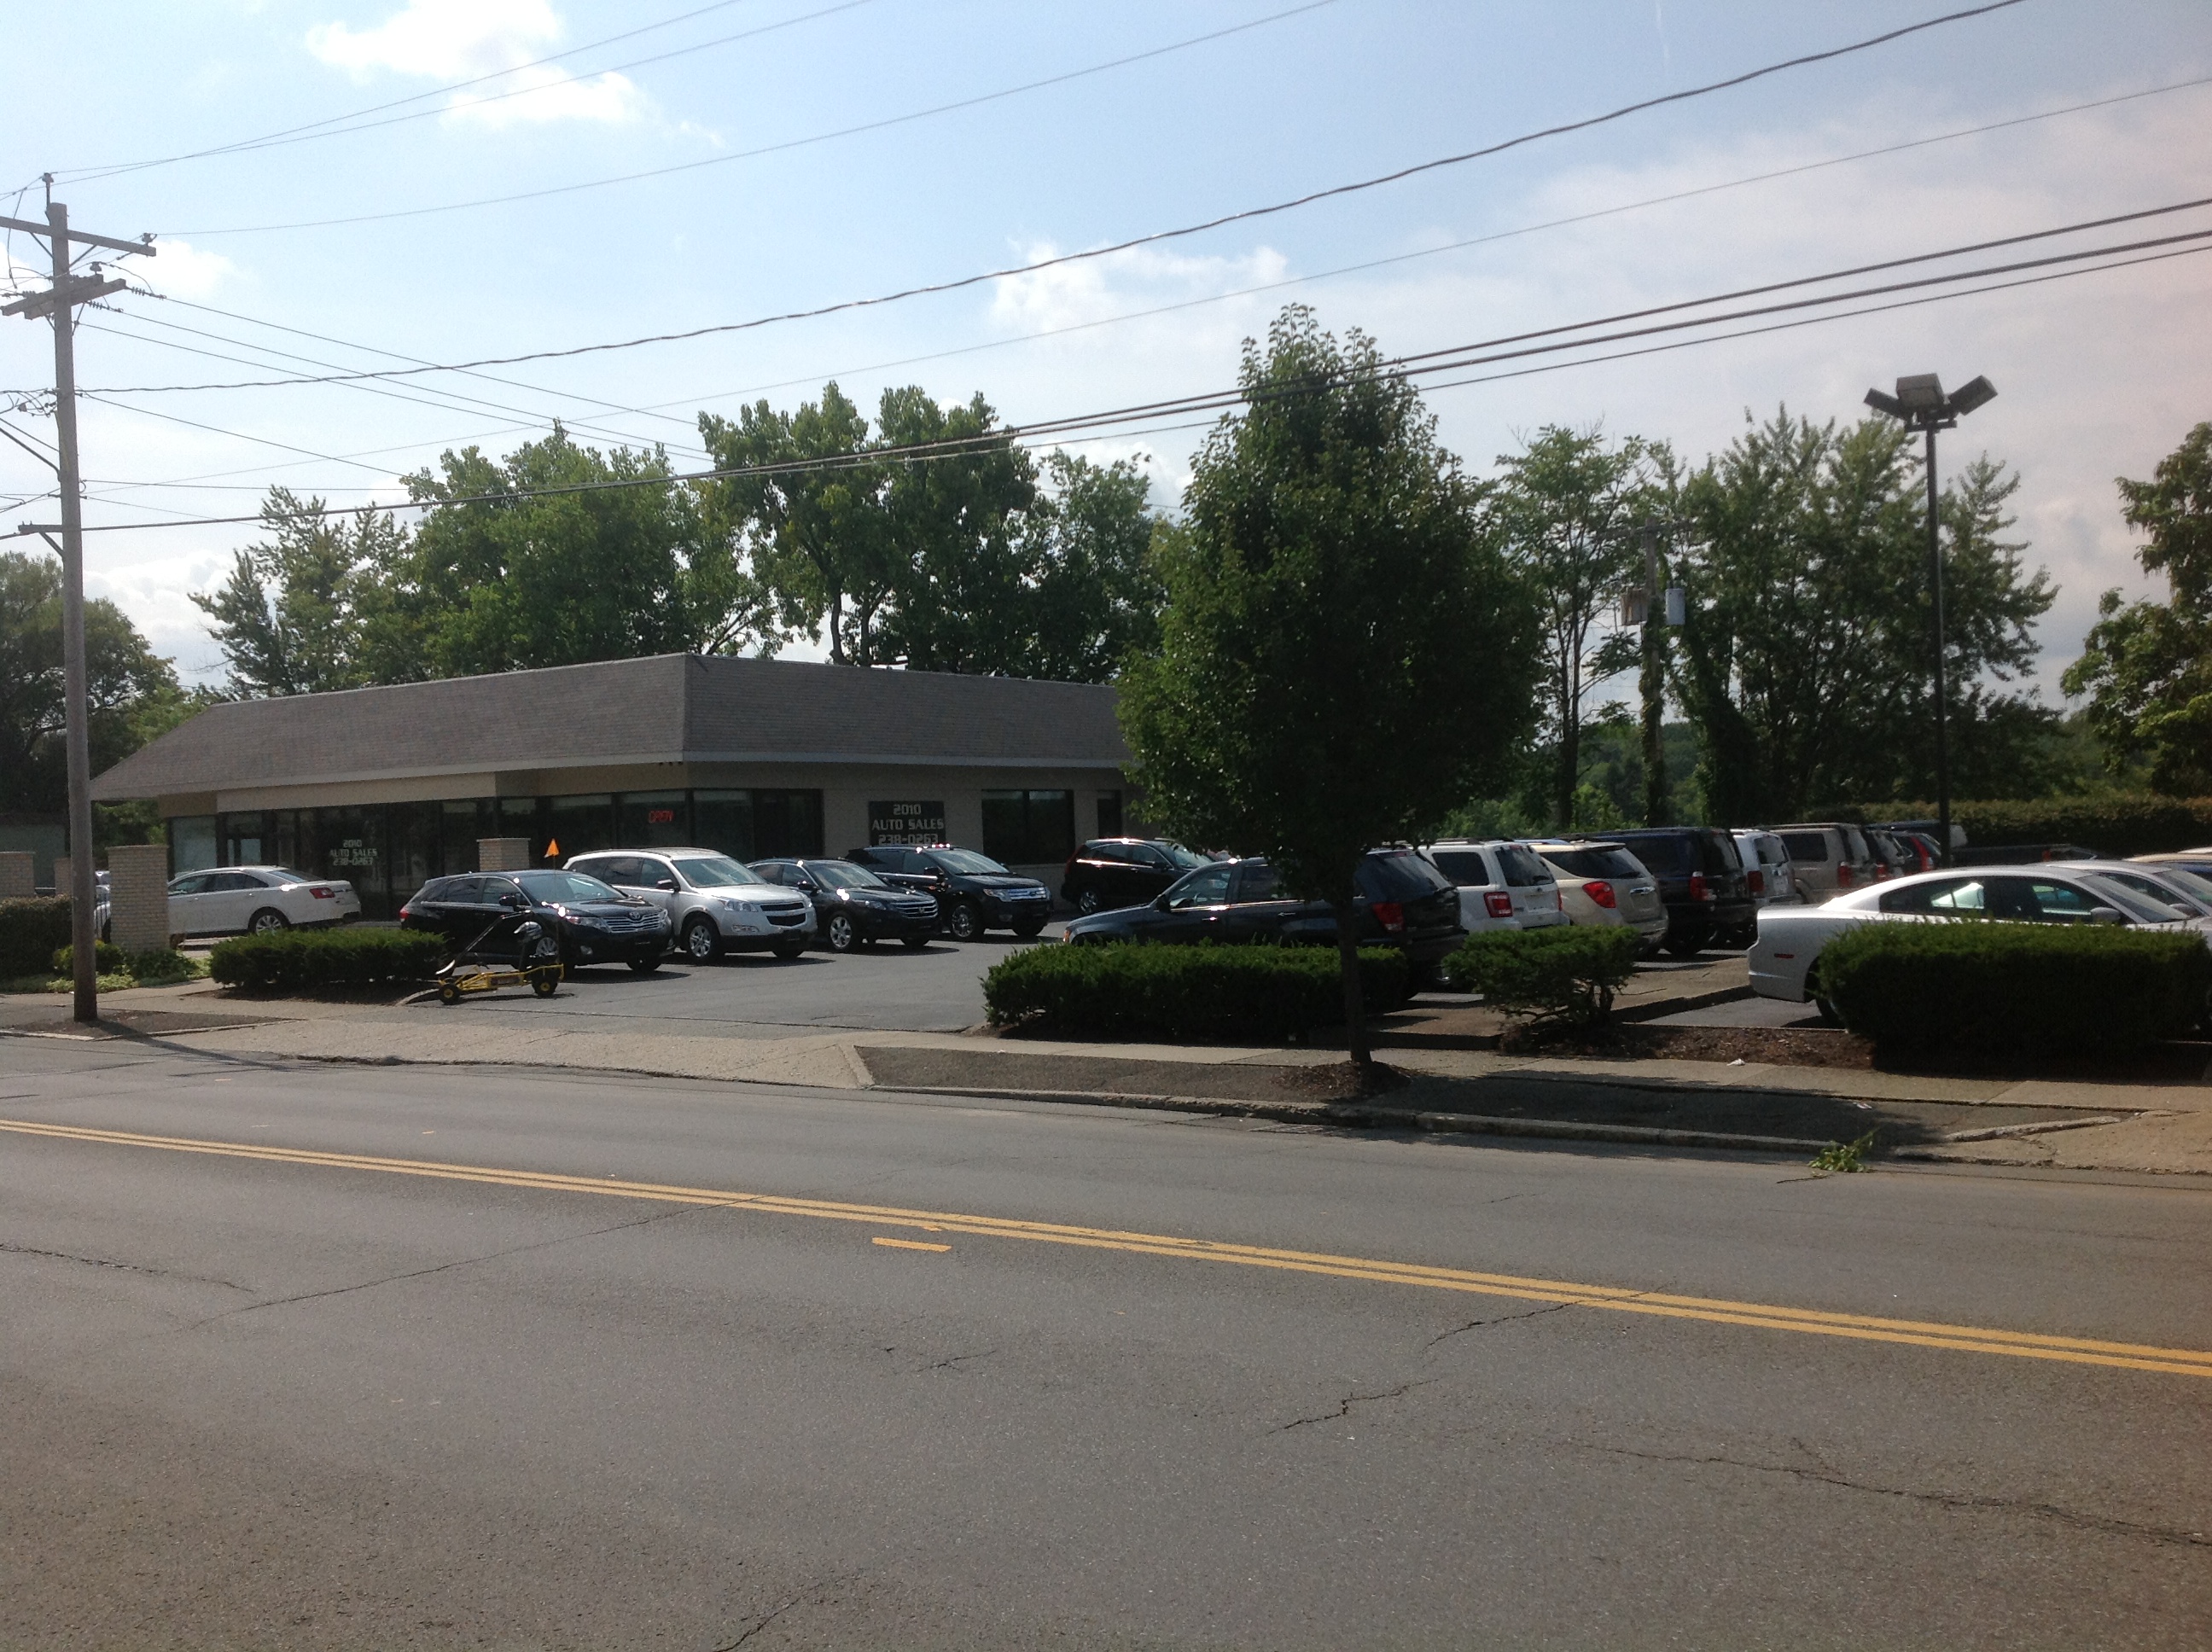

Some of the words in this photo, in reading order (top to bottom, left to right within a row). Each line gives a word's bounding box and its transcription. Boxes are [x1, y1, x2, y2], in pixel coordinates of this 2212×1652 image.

[893, 804, 922, 815] 2010
[871, 819, 903, 830] AUTO
[908, 818, 944, 829] SALES
[878, 834, 938, 846] 238-0263
